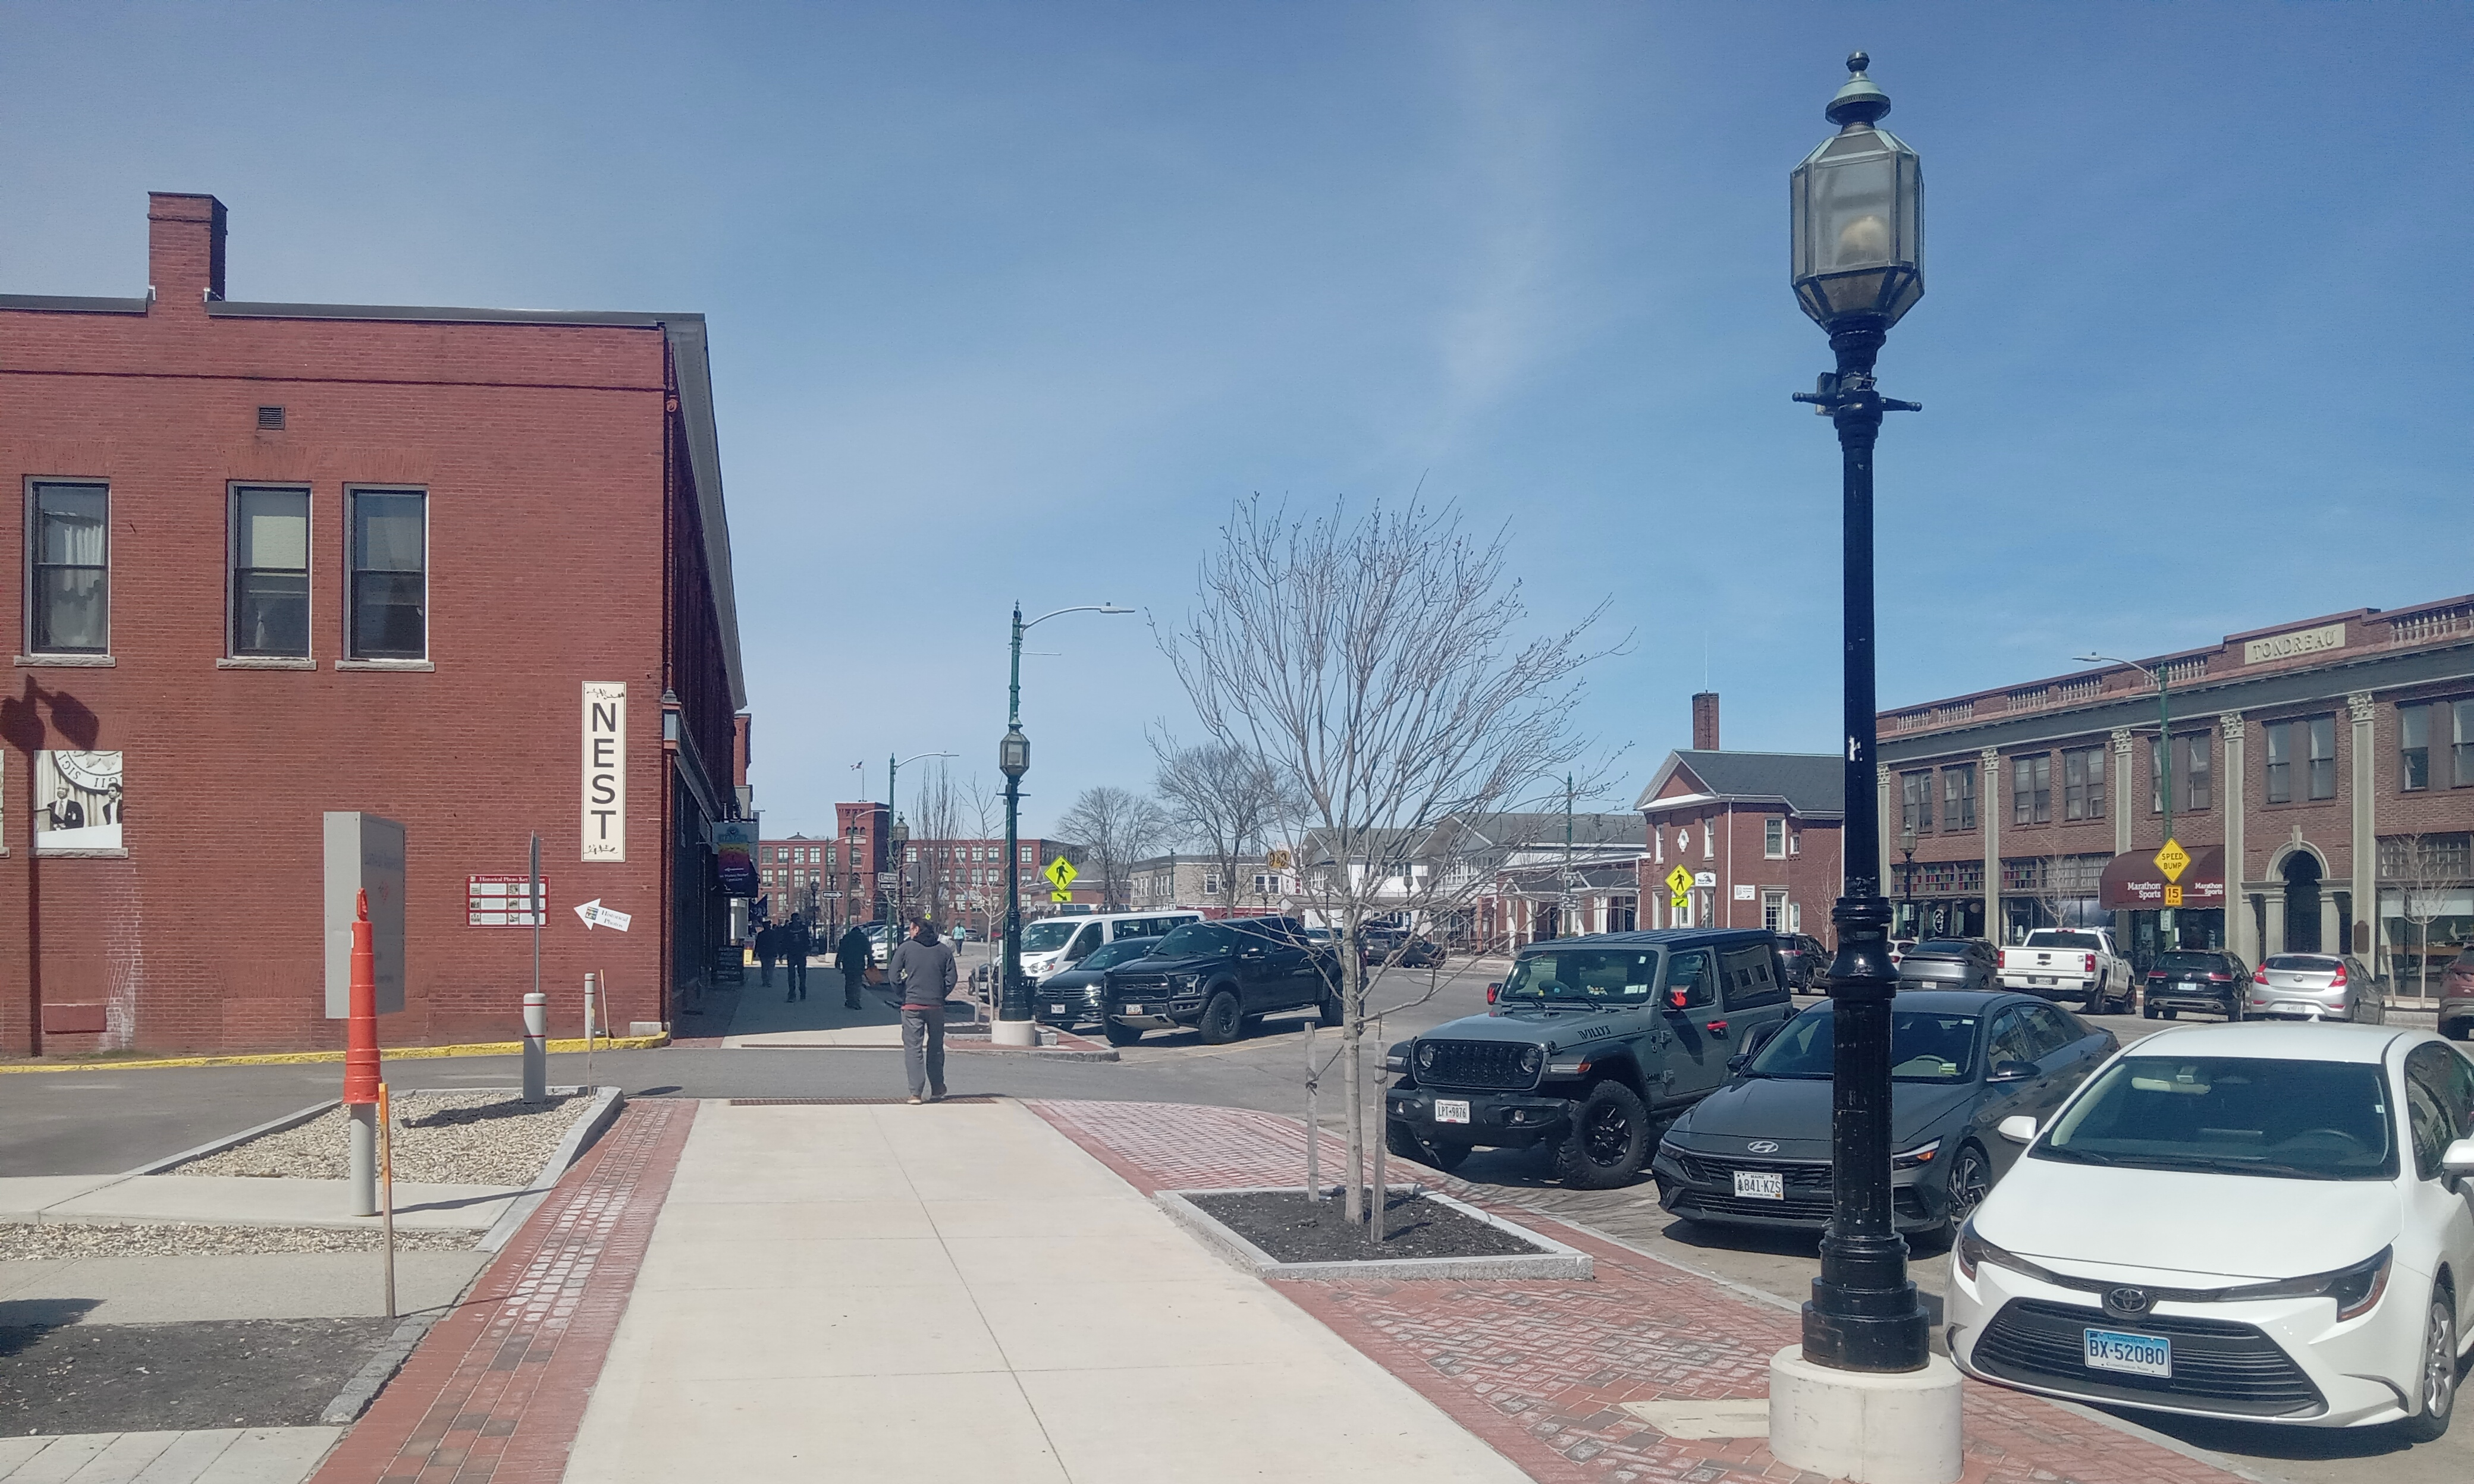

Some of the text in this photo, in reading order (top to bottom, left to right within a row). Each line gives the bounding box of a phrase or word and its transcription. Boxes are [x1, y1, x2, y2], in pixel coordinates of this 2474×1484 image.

[2253, 630, 2336, 660] TONDREAU
[591, 702, 617, 840] NEST
[2127, 882, 2162, 891] Marathon
[2139, 891, 2161, 900] Sports
[2168, 888, 2179, 898] 15
[602, 910, 629, 922] Historical
[604, 918, 623, 928] Photos
[1577, 1025, 1611, 1040] WILLYS
[2108, 1335, 2146, 1344] Connecticut
